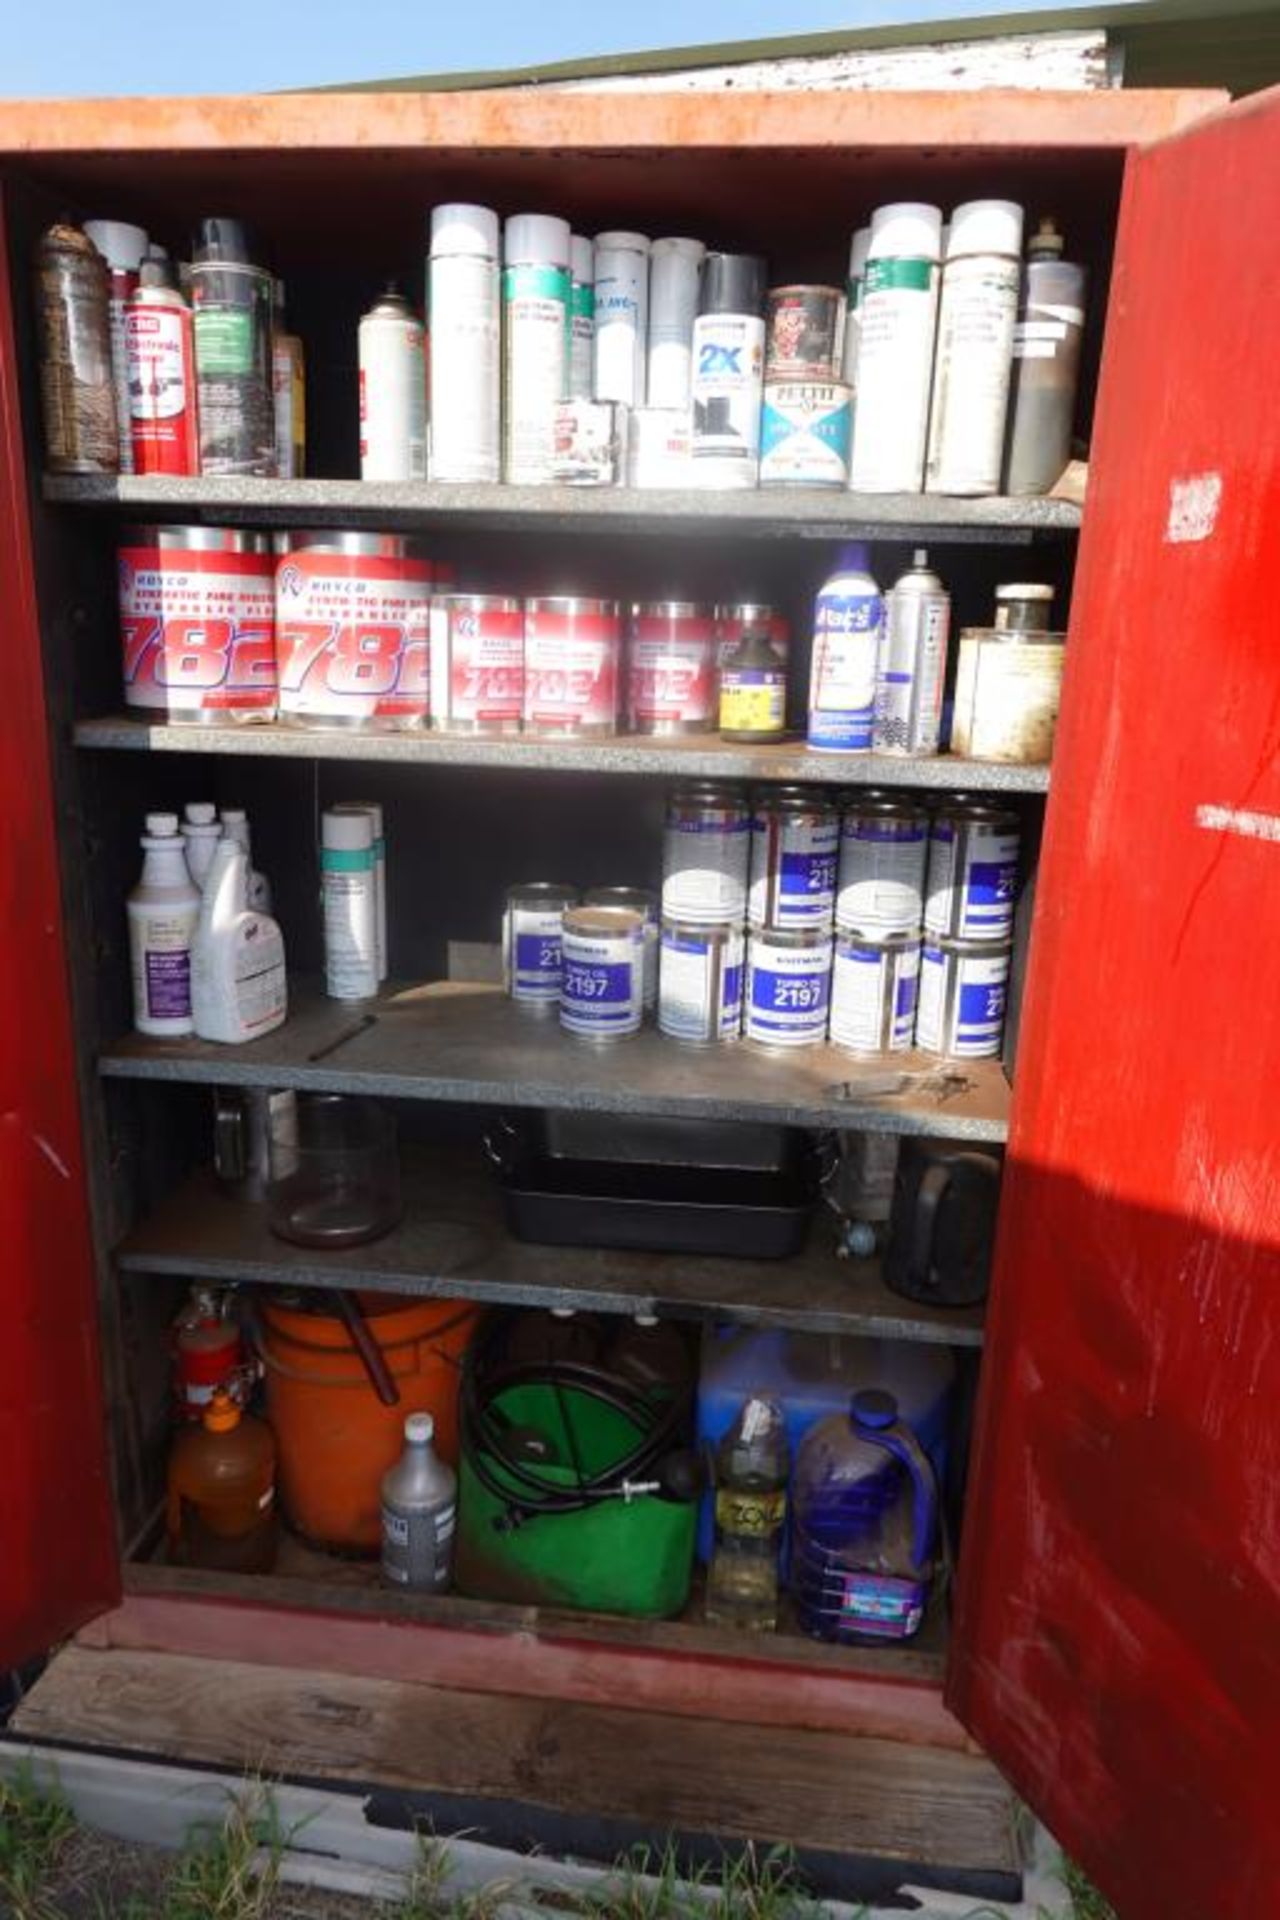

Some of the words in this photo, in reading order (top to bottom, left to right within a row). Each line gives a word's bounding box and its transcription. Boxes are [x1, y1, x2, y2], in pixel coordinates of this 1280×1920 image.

[698, 343, 744, 376] 2X
[565, 974, 608, 997] 2197
[774, 987, 821, 1007] 2197
